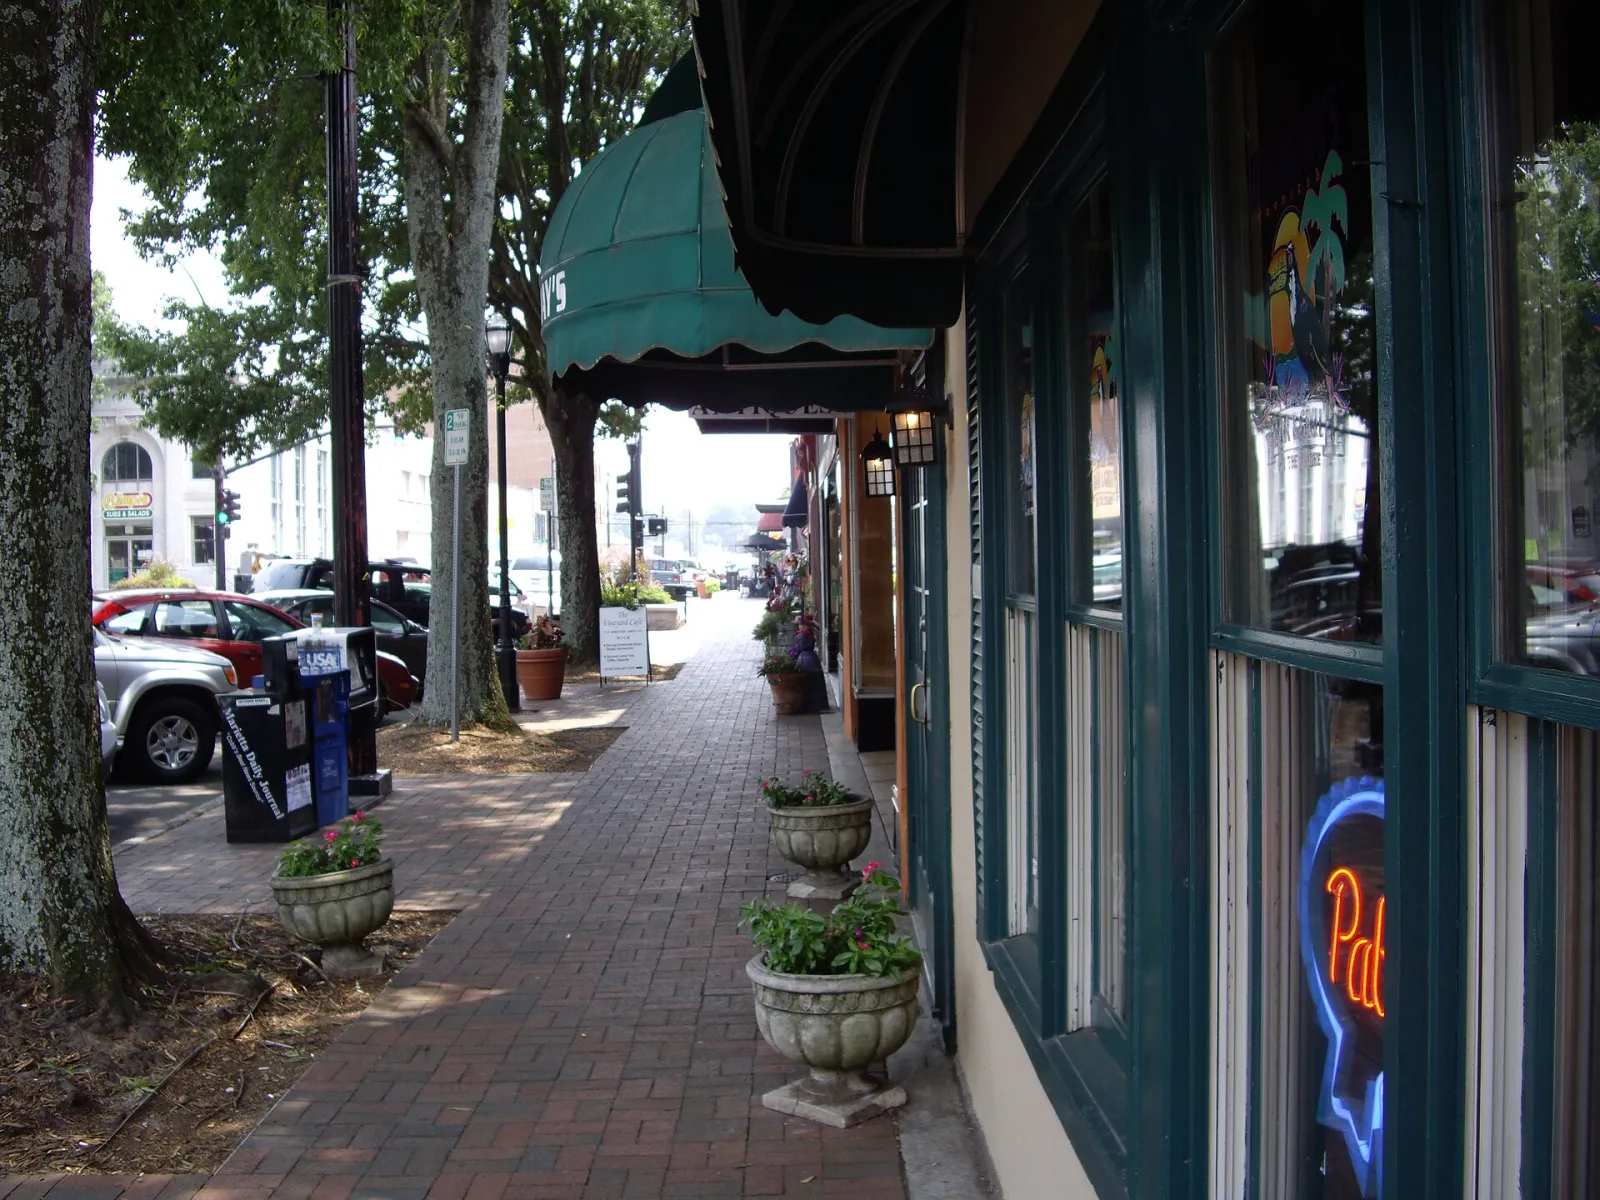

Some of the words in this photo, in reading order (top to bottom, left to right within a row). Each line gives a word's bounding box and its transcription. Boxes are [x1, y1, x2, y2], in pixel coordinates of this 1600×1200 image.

[447, 414, 453, 429] 2
[106, 510, 121, 518] SUBS
[306, 652, 337, 667] USA
[223, 707, 249, 752] Marietta
[246, 751, 263, 779] Daily
[259, 780, 285, 820] Journal
